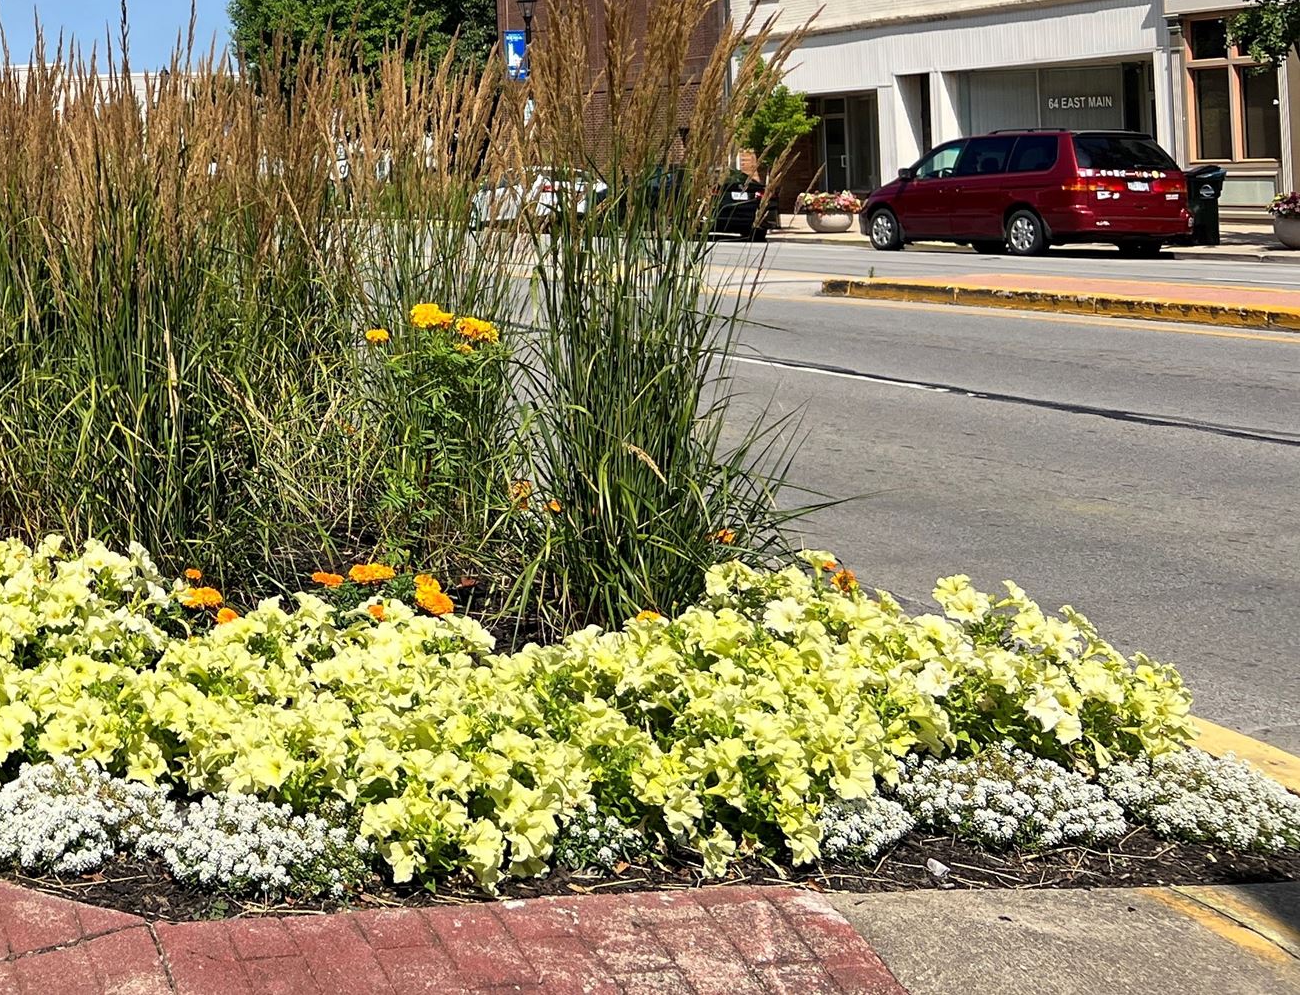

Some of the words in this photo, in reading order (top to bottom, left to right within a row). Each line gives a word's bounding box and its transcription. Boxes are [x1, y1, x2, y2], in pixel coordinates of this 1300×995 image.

[1048, 98, 1059, 109] 64
[1061, 97, 1086, 109] EAST
[1088, 96, 1113, 108] MAIN
